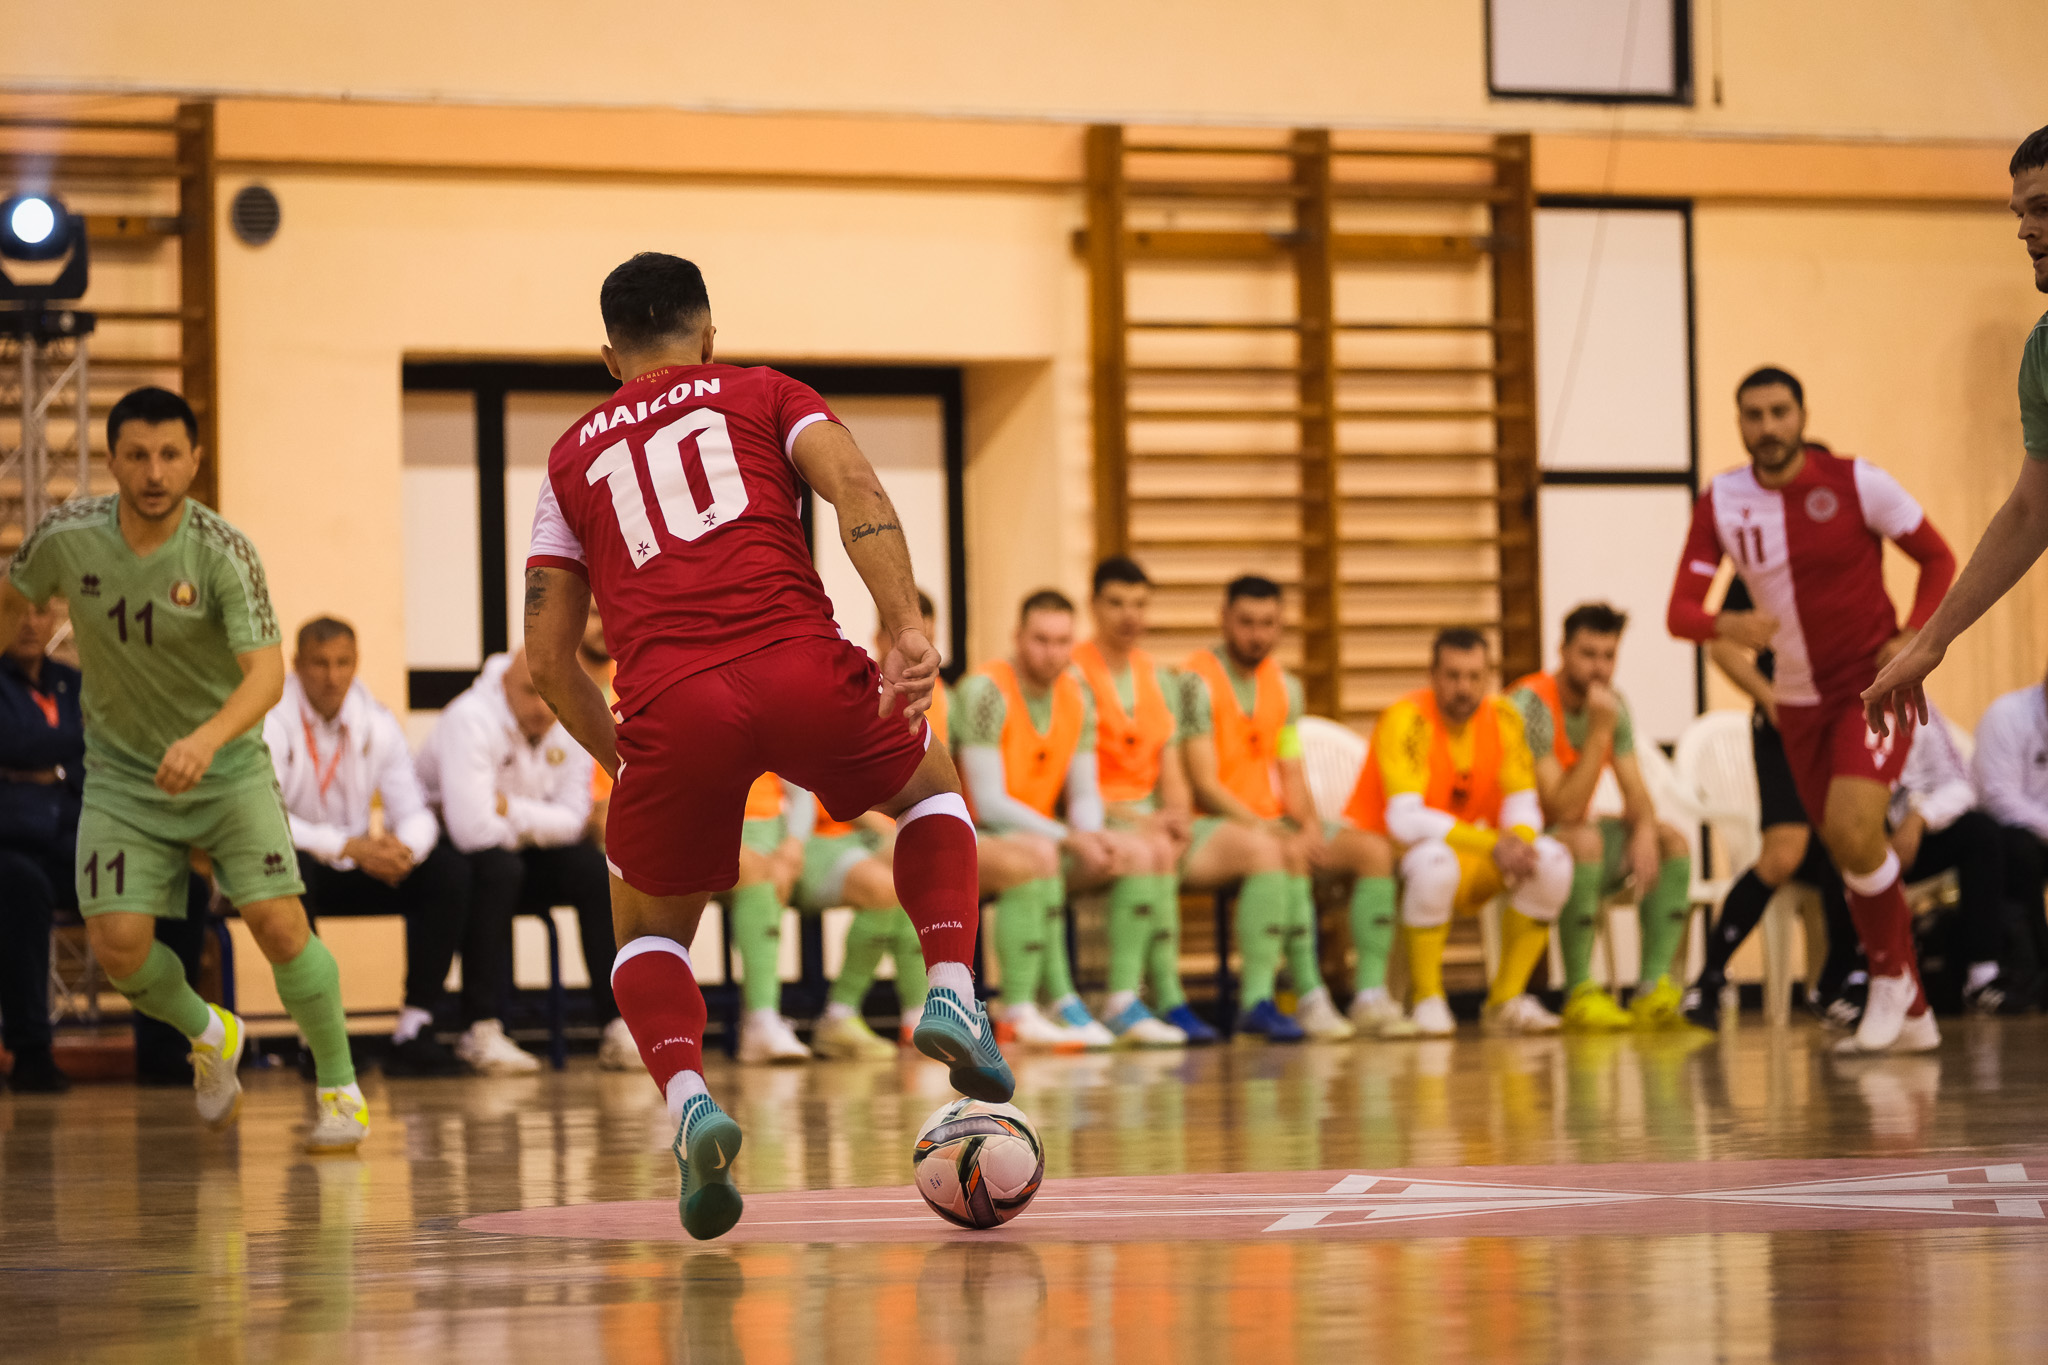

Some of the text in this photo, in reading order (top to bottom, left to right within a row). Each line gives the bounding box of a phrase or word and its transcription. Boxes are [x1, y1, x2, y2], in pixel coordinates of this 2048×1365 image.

[646, 369, 669, 379] MALTA
[579, 377, 721, 447] MAICON
[585, 407, 750, 570] 10
[1735, 525, 1766, 565] 11
[108, 596, 153, 647] 11
[84, 850, 125, 898] 11
[932, 920, 963, 931] MALTA
[664, 1036, 694, 1046] MALTA
